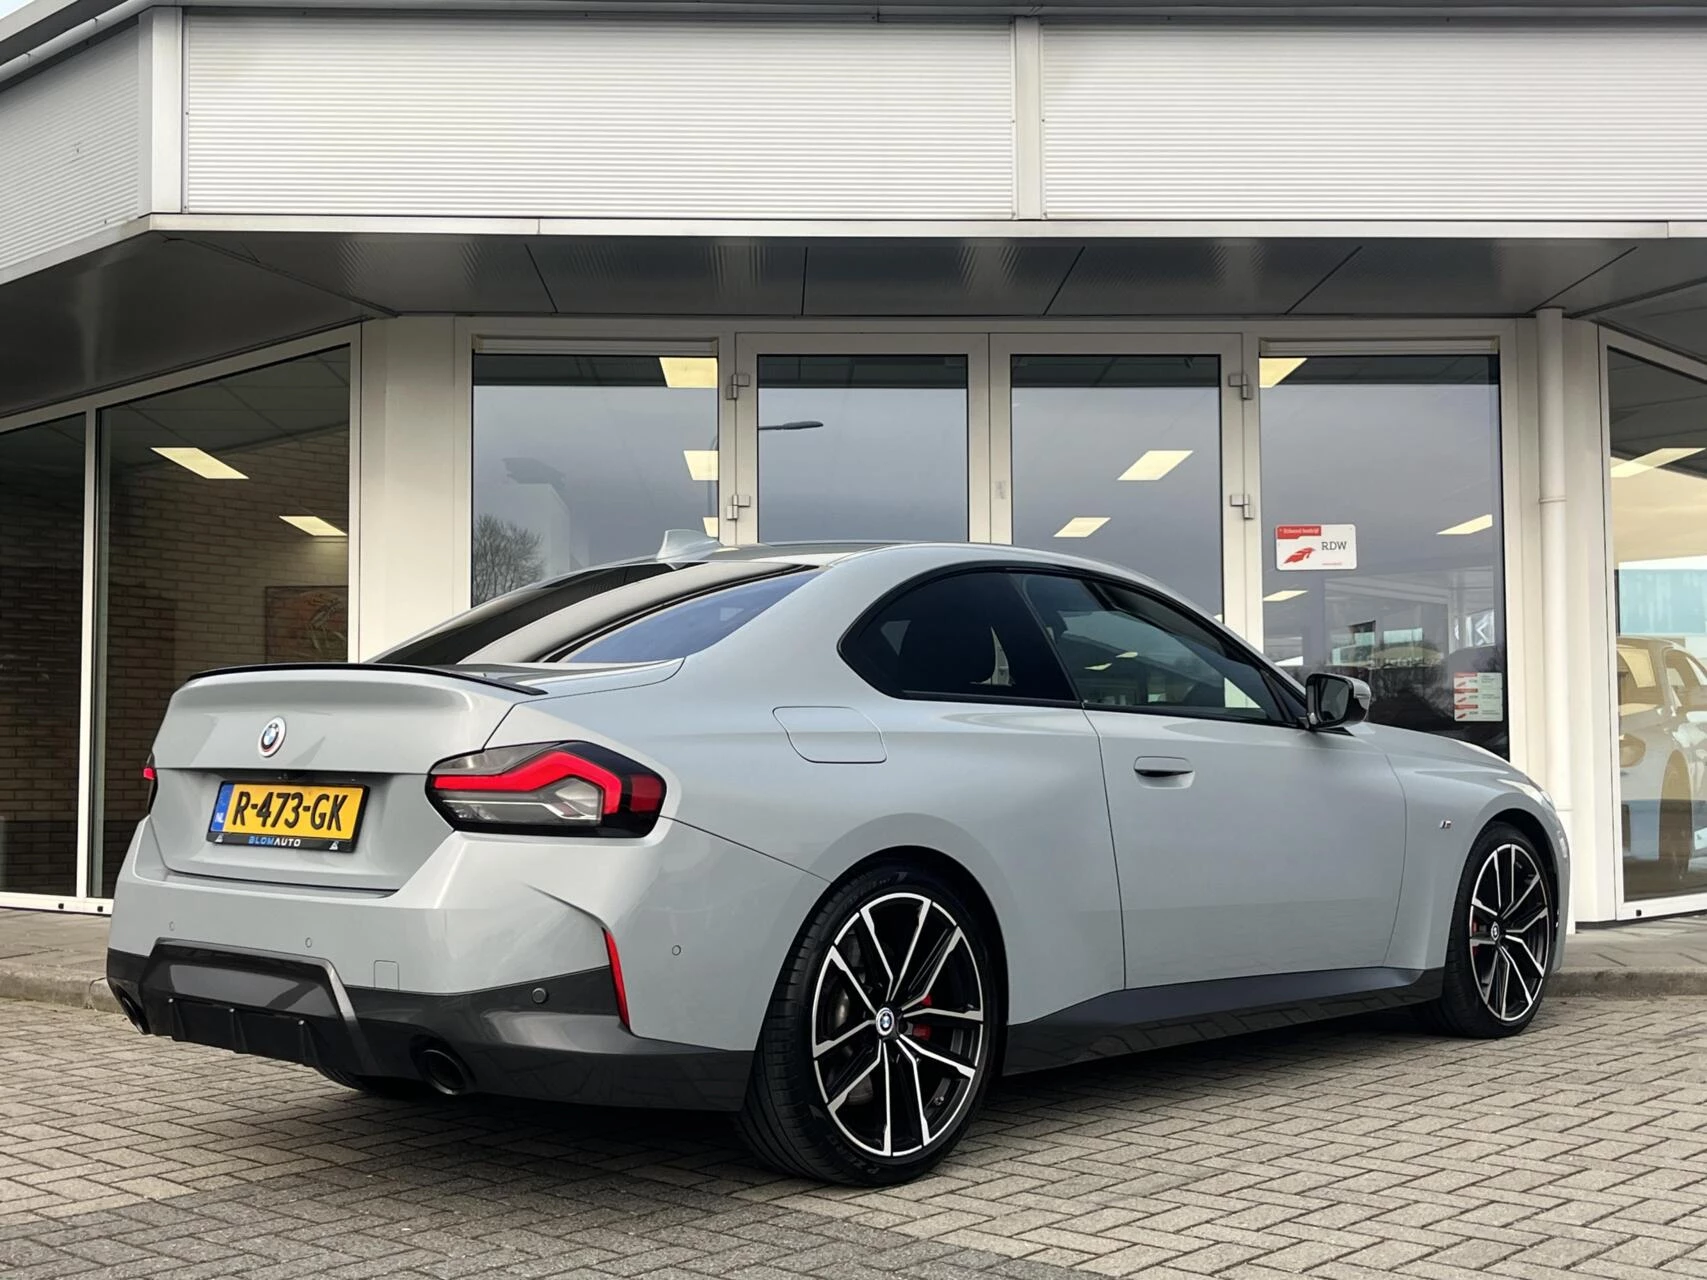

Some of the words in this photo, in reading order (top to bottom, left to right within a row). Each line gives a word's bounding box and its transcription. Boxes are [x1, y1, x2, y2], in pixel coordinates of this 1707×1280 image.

[1321, 541, 1347, 551] RDW
[232, 791, 348, 831] R-473-GK
[248, 836, 302, 848] BLOMAUTO
